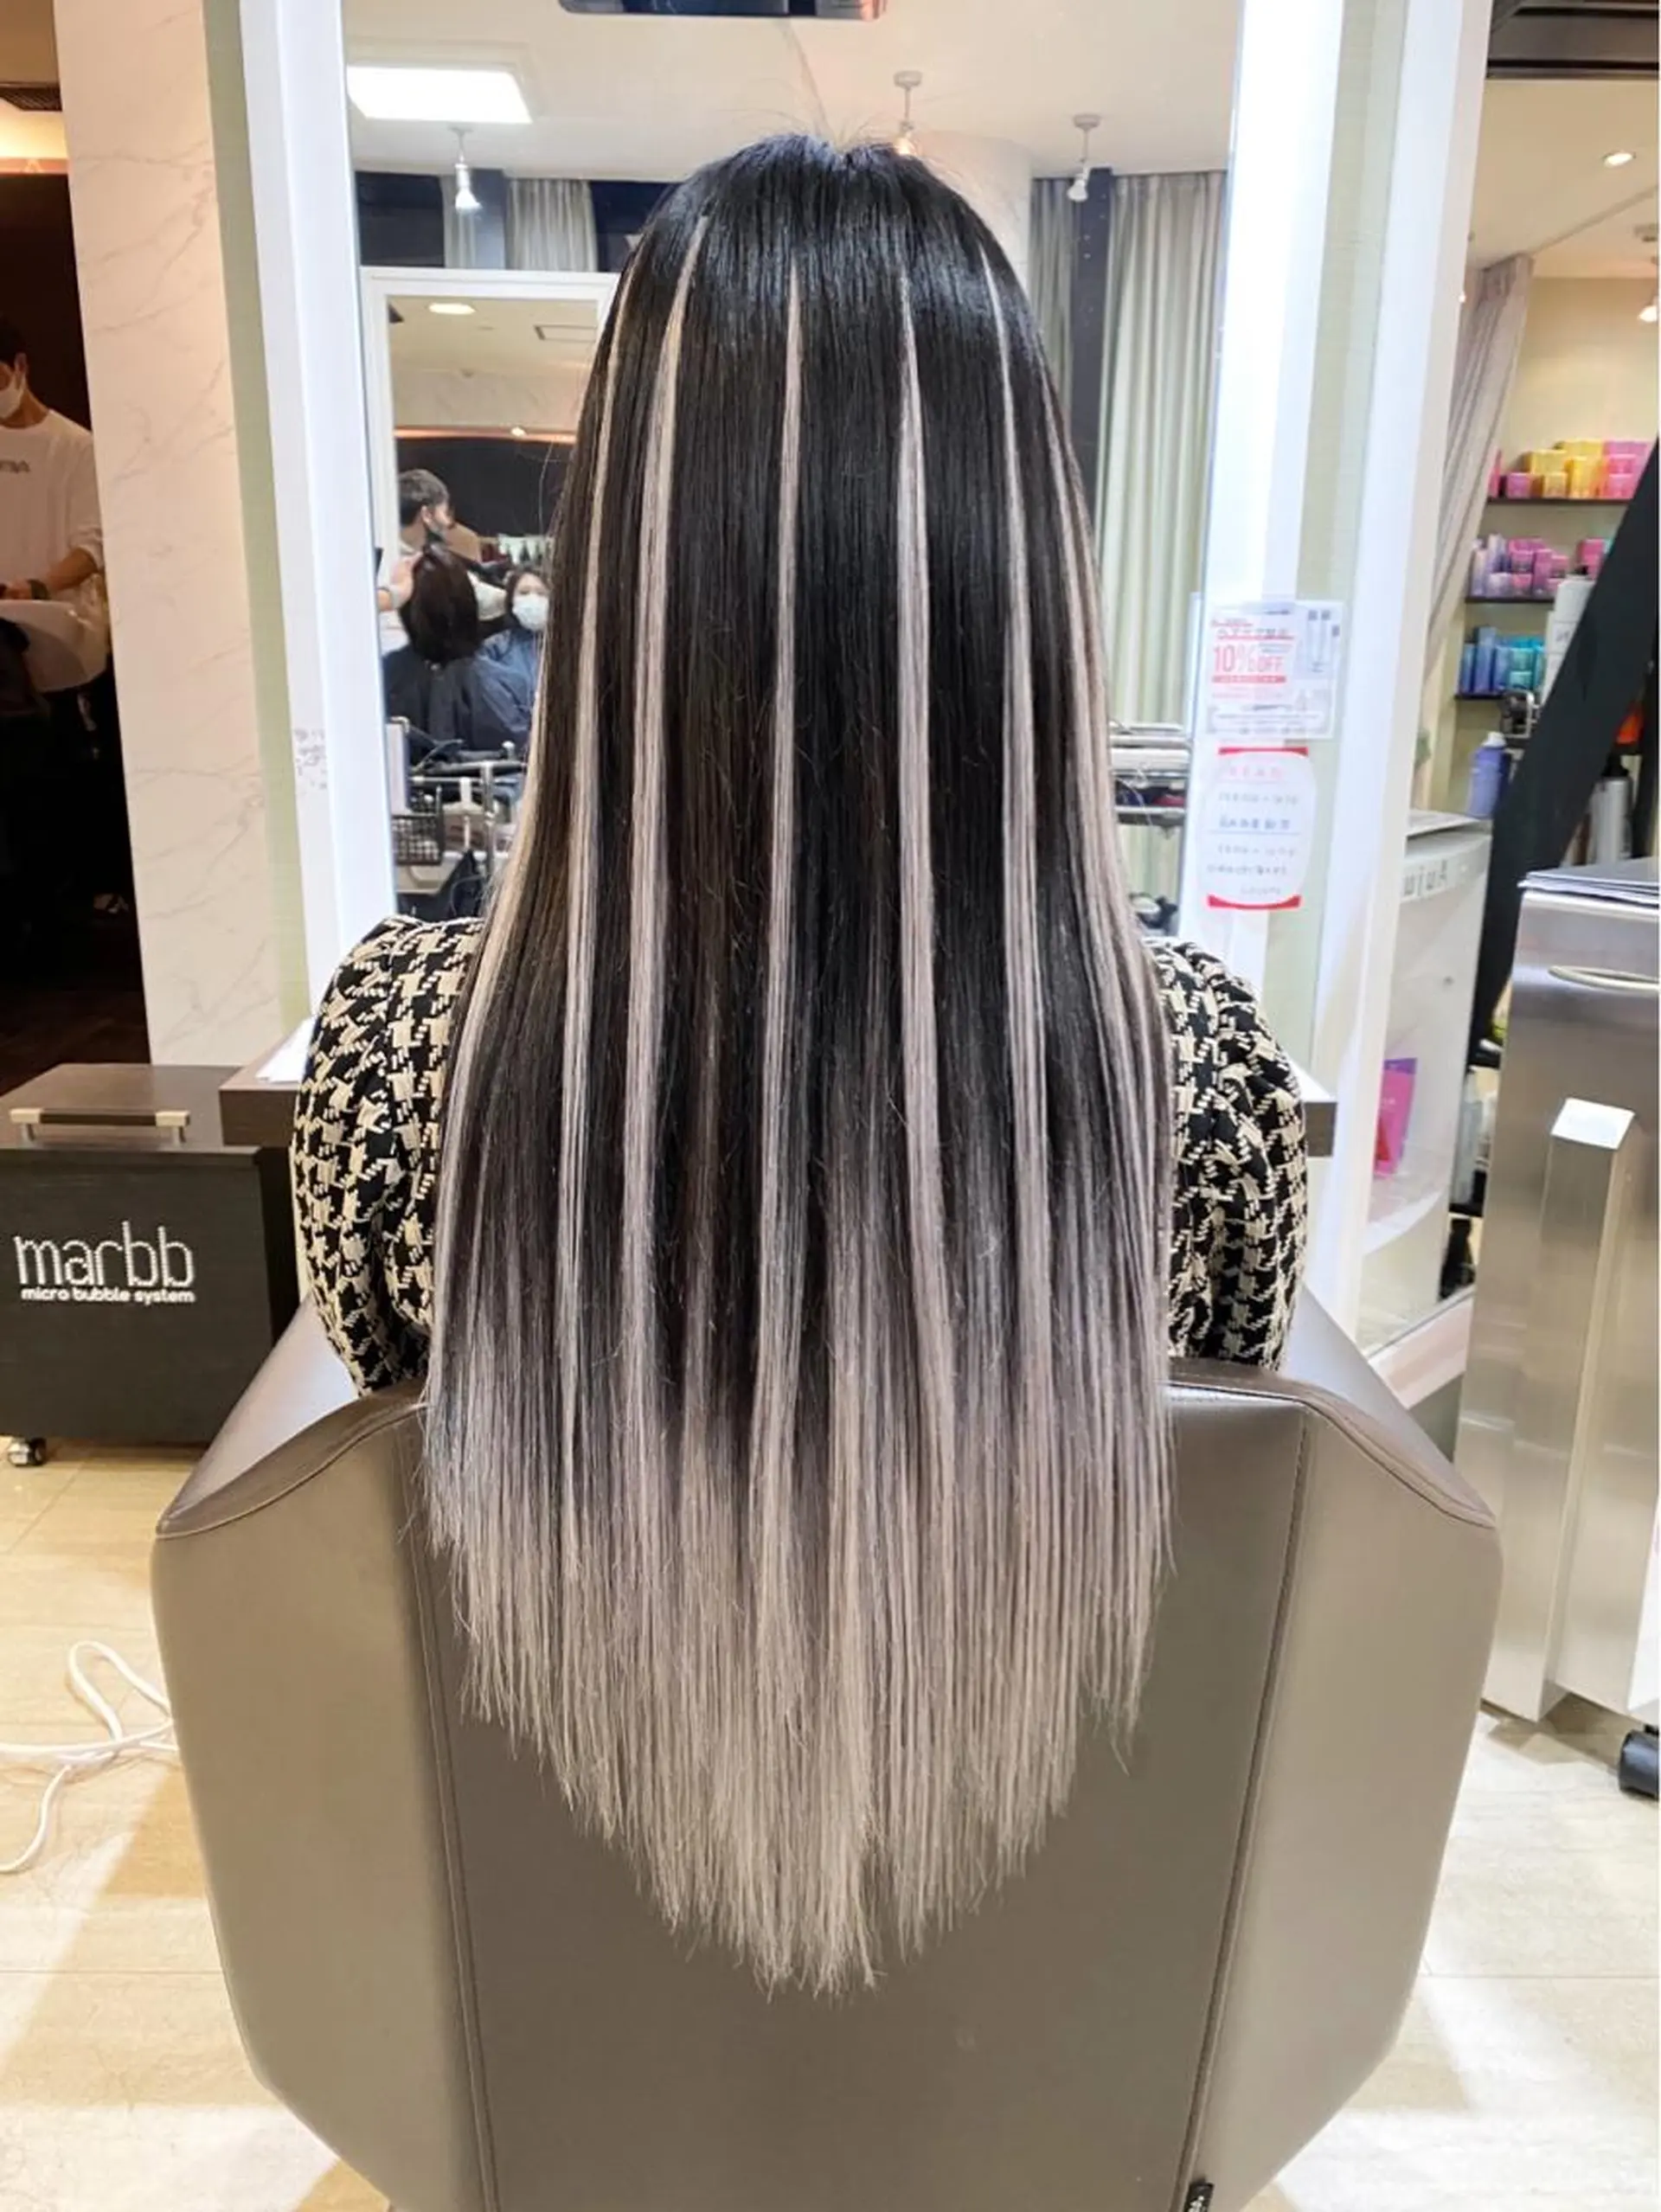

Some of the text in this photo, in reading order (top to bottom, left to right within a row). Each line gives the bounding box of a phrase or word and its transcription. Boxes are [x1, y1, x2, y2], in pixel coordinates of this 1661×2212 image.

[13, 1221, 195, 1287] marbb
[21, 1286, 196, 1306] micro bubble system
